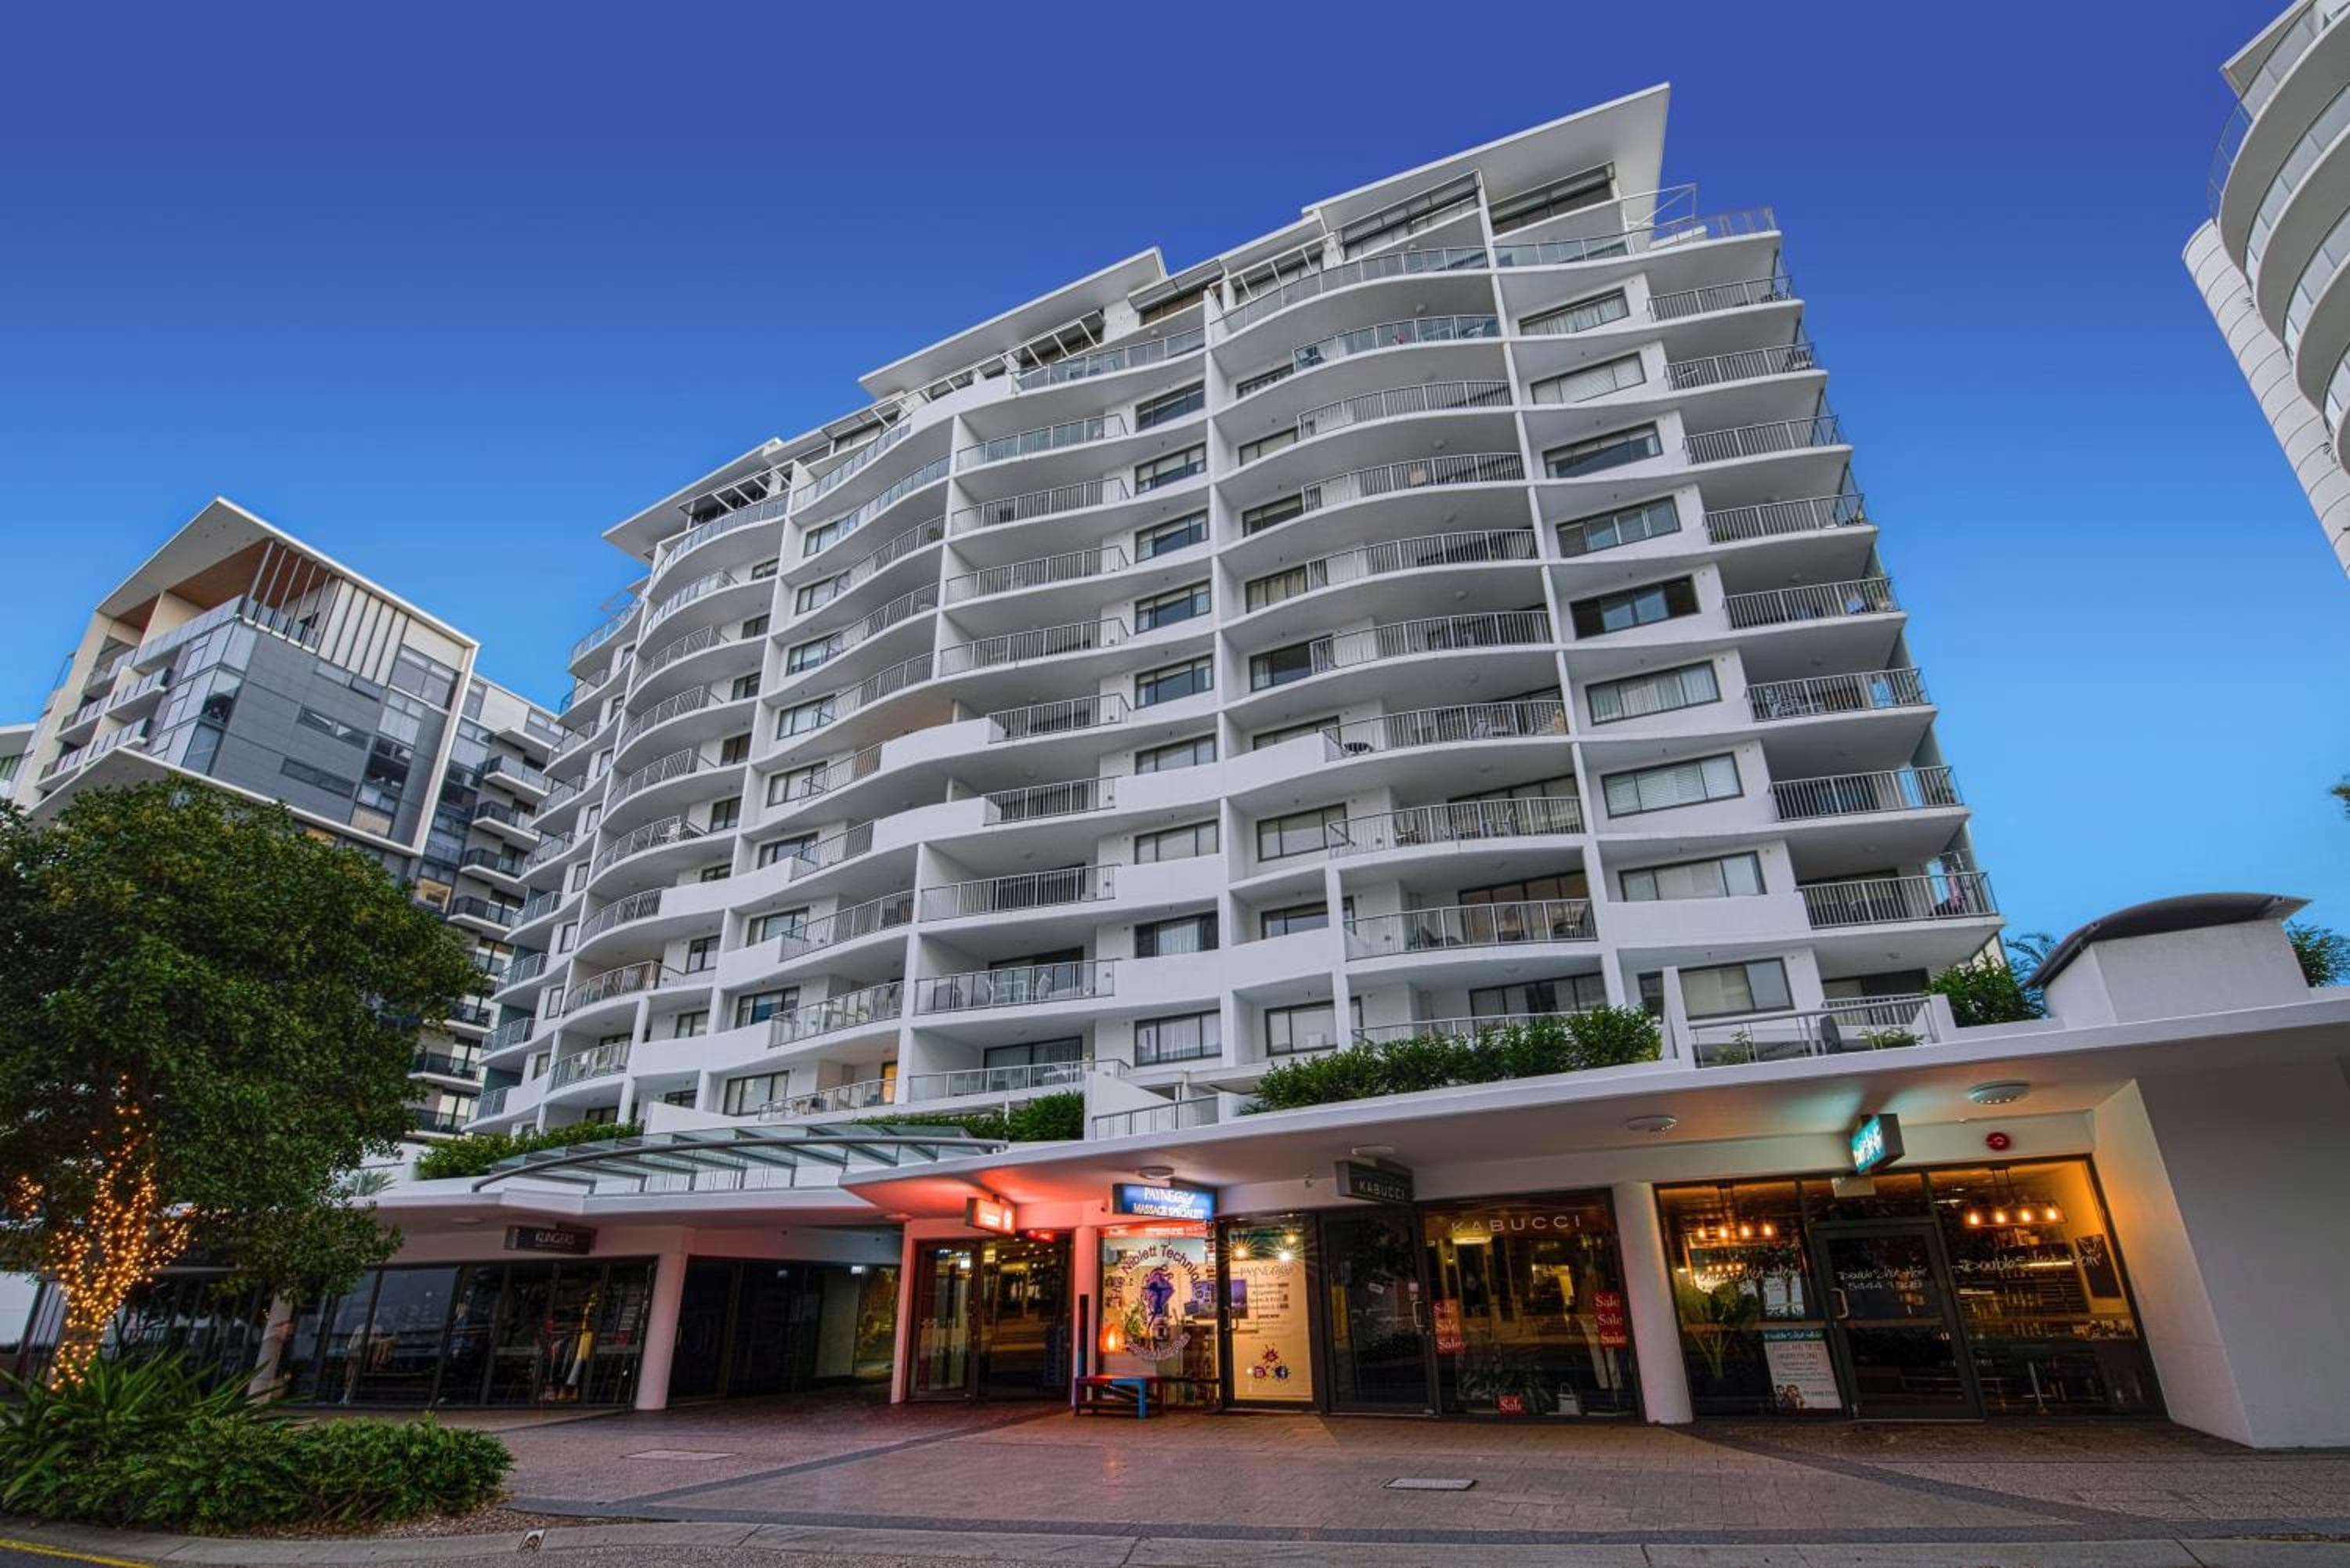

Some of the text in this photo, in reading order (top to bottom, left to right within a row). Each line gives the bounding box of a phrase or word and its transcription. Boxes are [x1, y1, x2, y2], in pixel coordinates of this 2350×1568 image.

[1359, 1180, 1405, 1201] KABUCCI
[1133, 1203, 1167, 1216] MASSAGE
[1452, 1215, 1580, 1232] KABUCCI
[1111, 1244, 1204, 1307] The Niblett Technique
[1595, 1295, 1621, 1308] Sale
[1598, 1313, 1623, 1326] Sale
